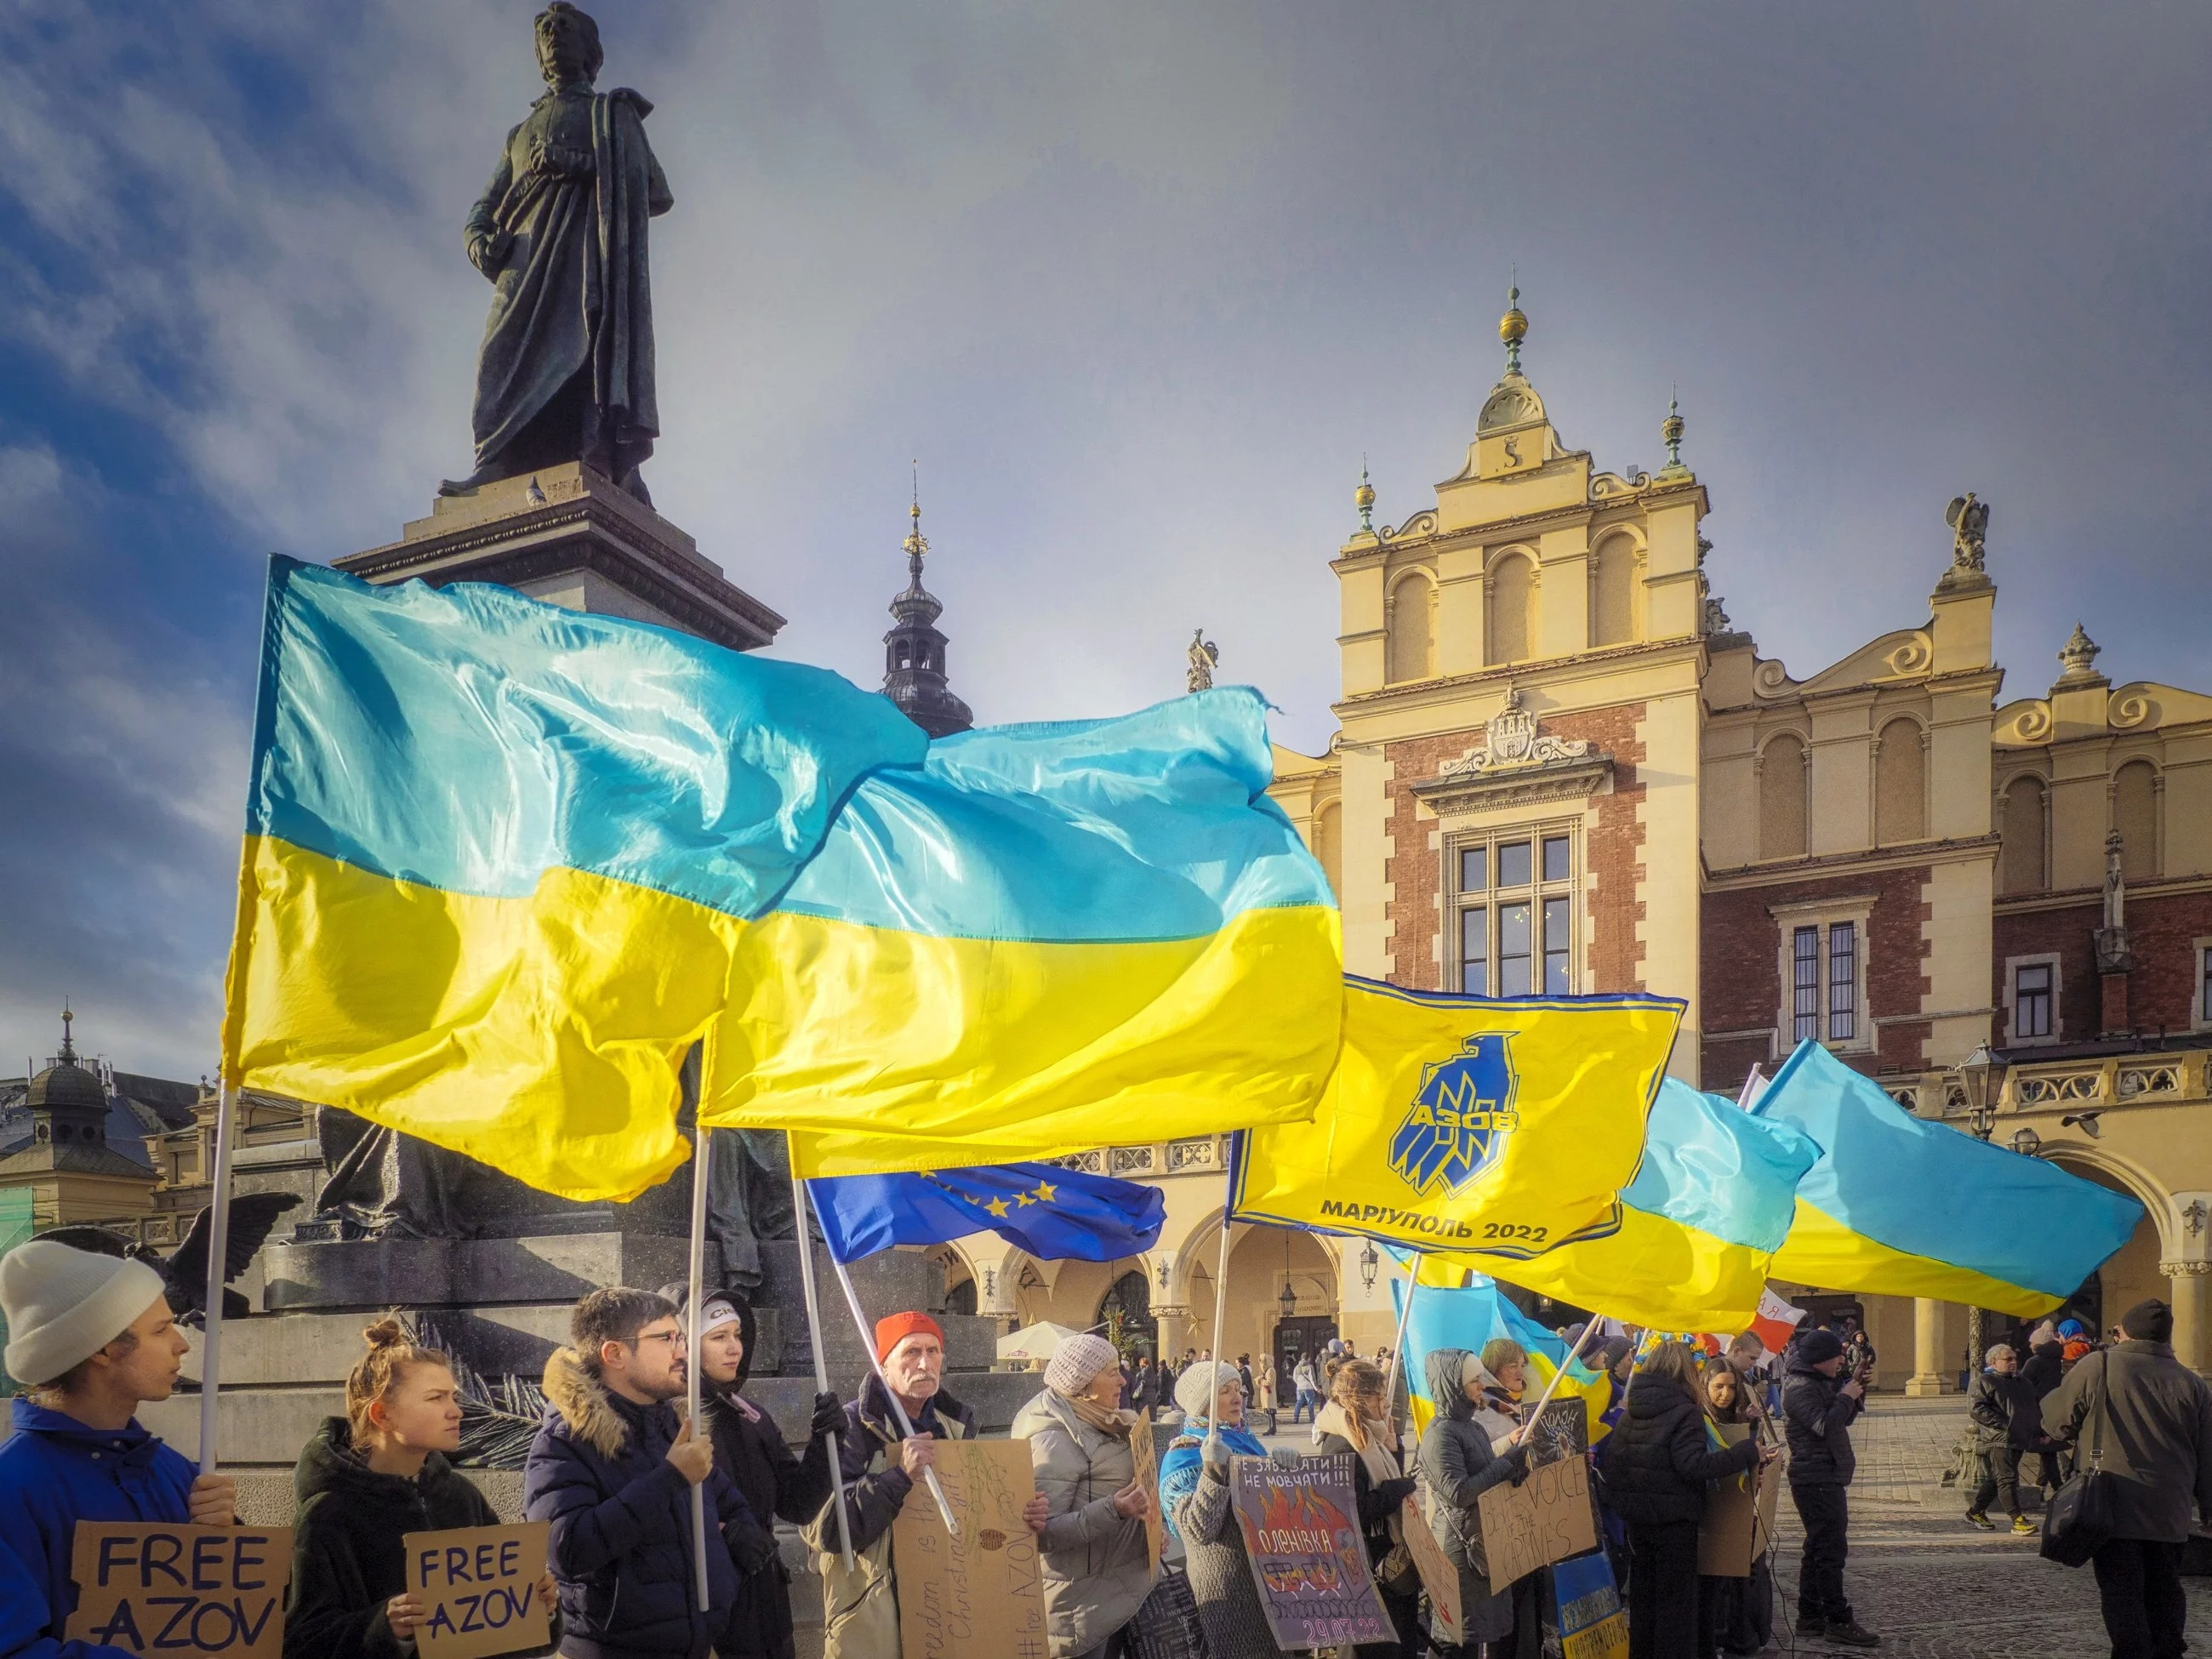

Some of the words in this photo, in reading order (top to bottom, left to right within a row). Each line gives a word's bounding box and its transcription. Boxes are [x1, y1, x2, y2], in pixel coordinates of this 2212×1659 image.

[1409, 1104, 1519, 1133] АЗОВ
[1320, 1200, 1474, 1239] МАРІУПОЛЬ
[1482, 1223, 1548, 1243] 2022
[940, 1471, 968, 1508] gift
[1245, 1474, 1261, 1488] НЕ
[1525, 1456, 1586, 1509] VOICE
[918, 1535, 937, 1554] is
[1517, 1513, 1536, 1531] THE
[98, 1533, 270, 1591] FREE
[420, 1541, 521, 1588] FREE
[1006, 1528, 1037, 1598] AZOV
[1502, 1518, 1572, 1582] CAPTIVES
[90, 1596, 276, 1652] AZOV
[426, 1582, 534, 1640] AZOV
[916, 1581, 944, 1659] reedom
